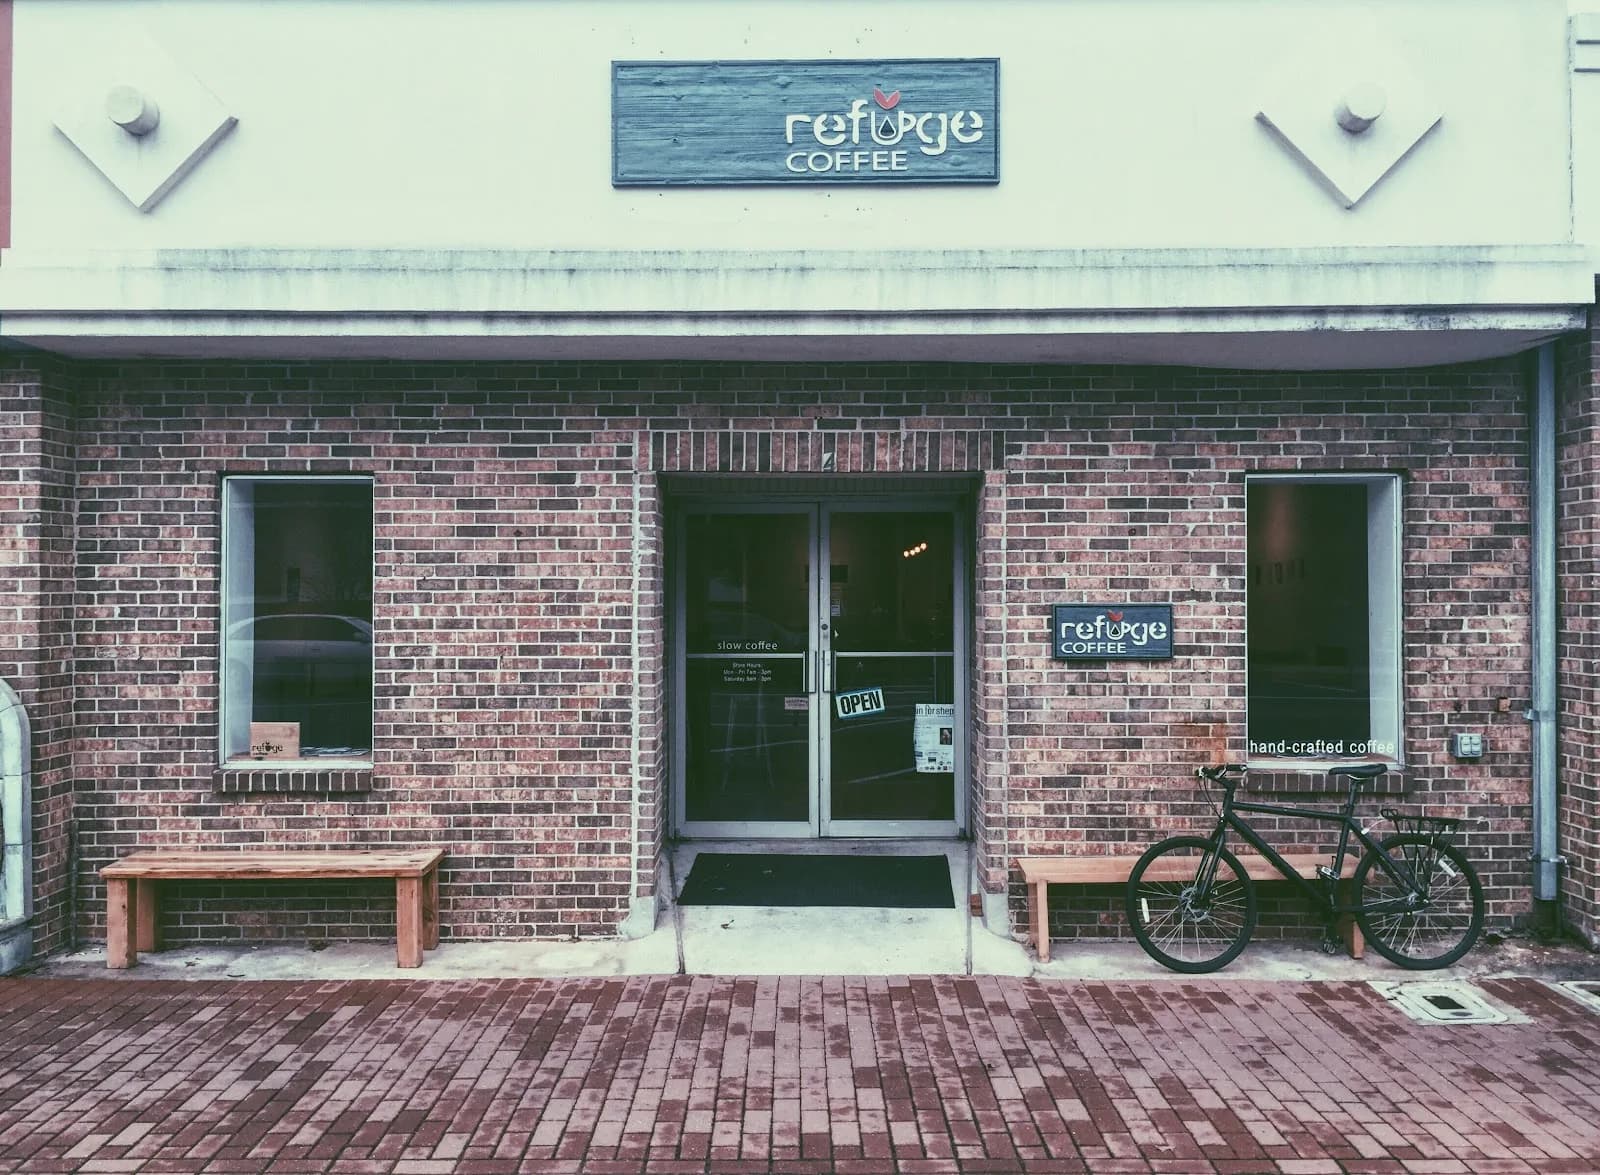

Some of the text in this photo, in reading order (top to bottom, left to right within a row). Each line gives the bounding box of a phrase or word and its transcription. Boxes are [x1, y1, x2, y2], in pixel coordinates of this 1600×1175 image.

[786, 99, 984, 155] refuge
[786, 151, 908, 172] COFFEE
[1061, 615, 1167, 645] refuge
[717, 640, 778, 650] slow coffee
[1061, 642, 1126, 653] COFFEE
[841, 691, 881, 714] OPEN
[1250, 740, 1394, 753] hand-crafted coffee
